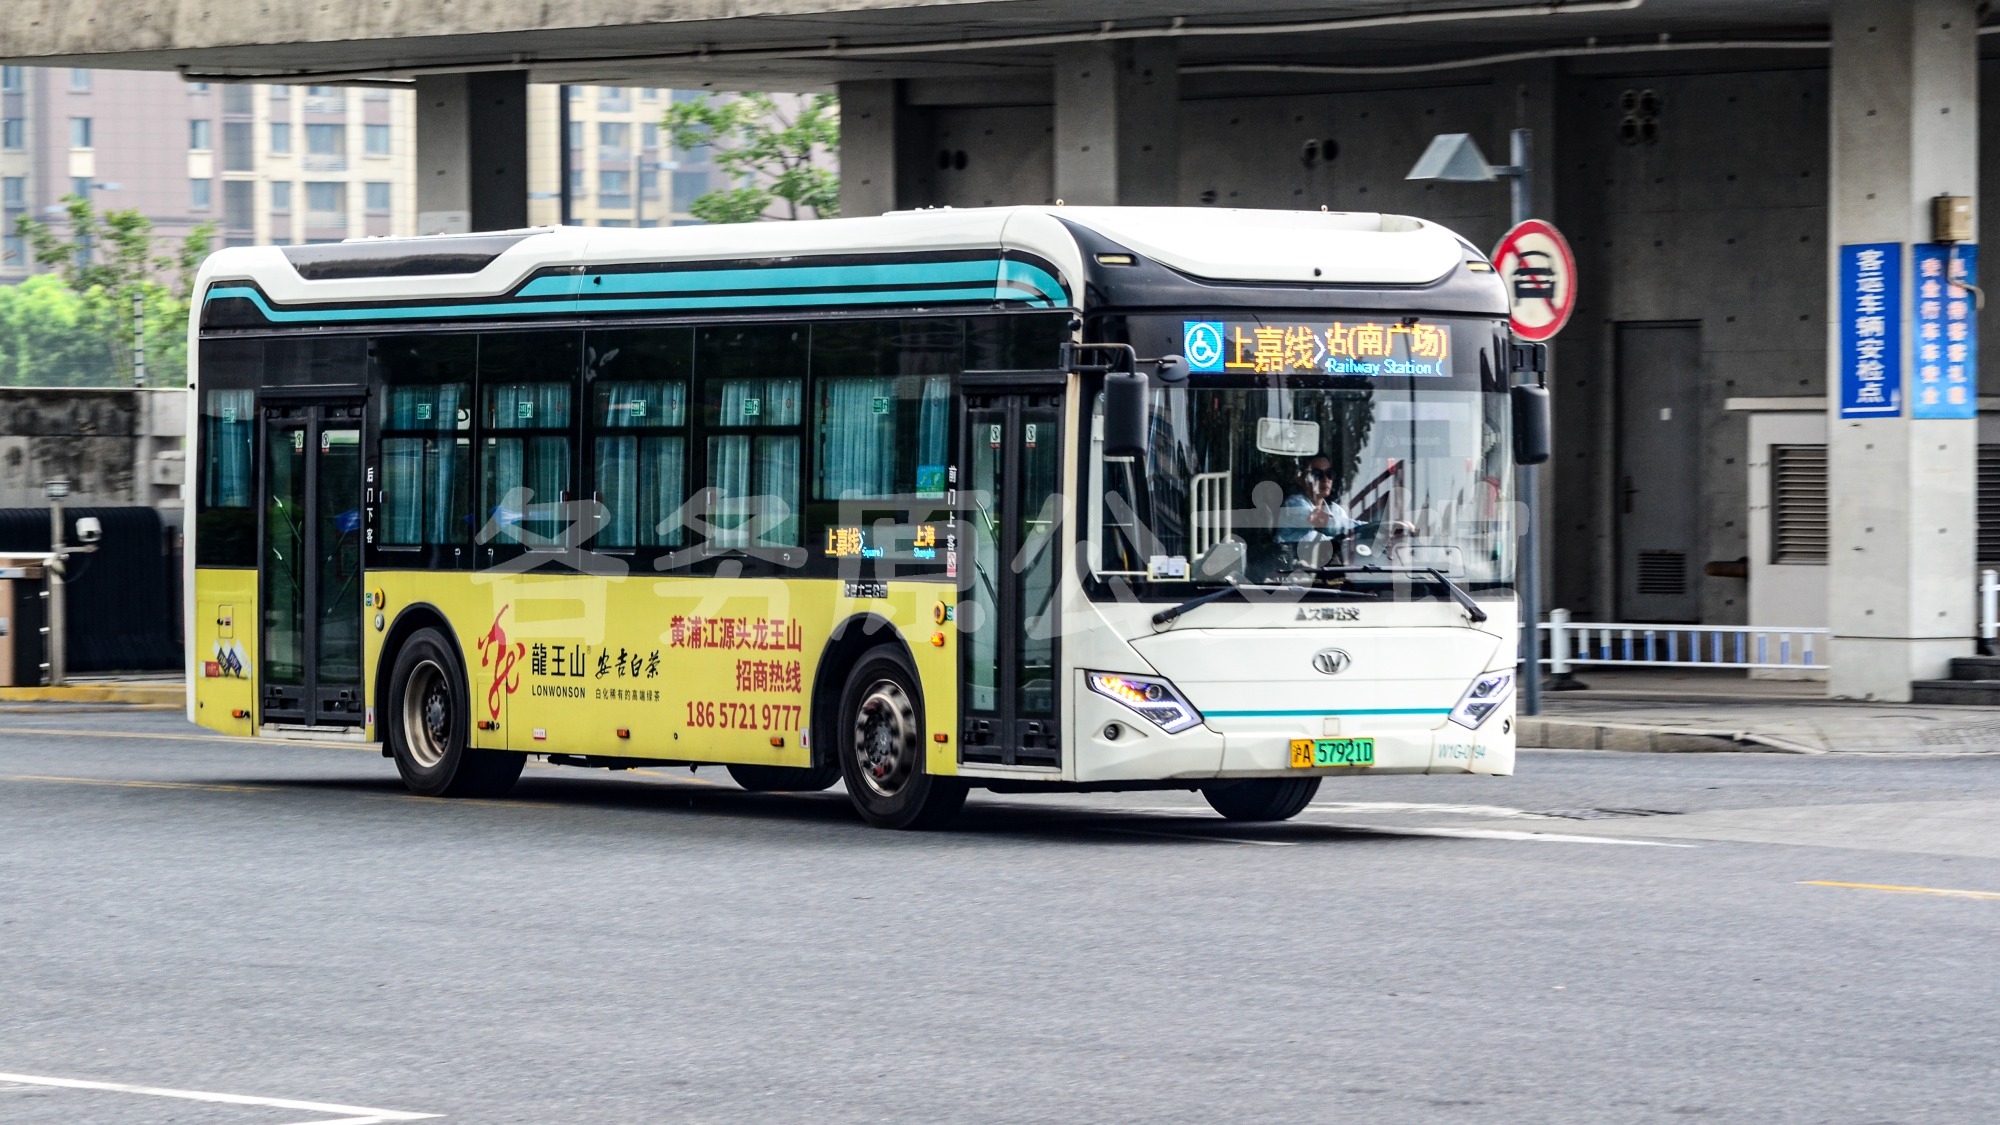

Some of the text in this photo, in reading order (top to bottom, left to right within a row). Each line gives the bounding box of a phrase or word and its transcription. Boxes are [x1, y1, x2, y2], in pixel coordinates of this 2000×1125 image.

[1856, 249, 1885, 403] 客运车辆安检点
[1225, 326, 1314, 373] 上嘉线
[1327, 359, 1379, 377] Railway
[1383, 359, 1432, 375] Station
[366, 467, 374, 543] 后门下客
[825, 527, 859, 556] 上嘉线
[670, 615, 802, 652] 黄浦江源头龙王山
[531, 642, 586, 678] 龍王山
[595, 647, 661, 680] 安吉白茶
[736, 659, 802, 693] 招商热线
[531, 685, 586, 699] LONWONSON
[686, 701, 802, 731] 186 5721 9777
